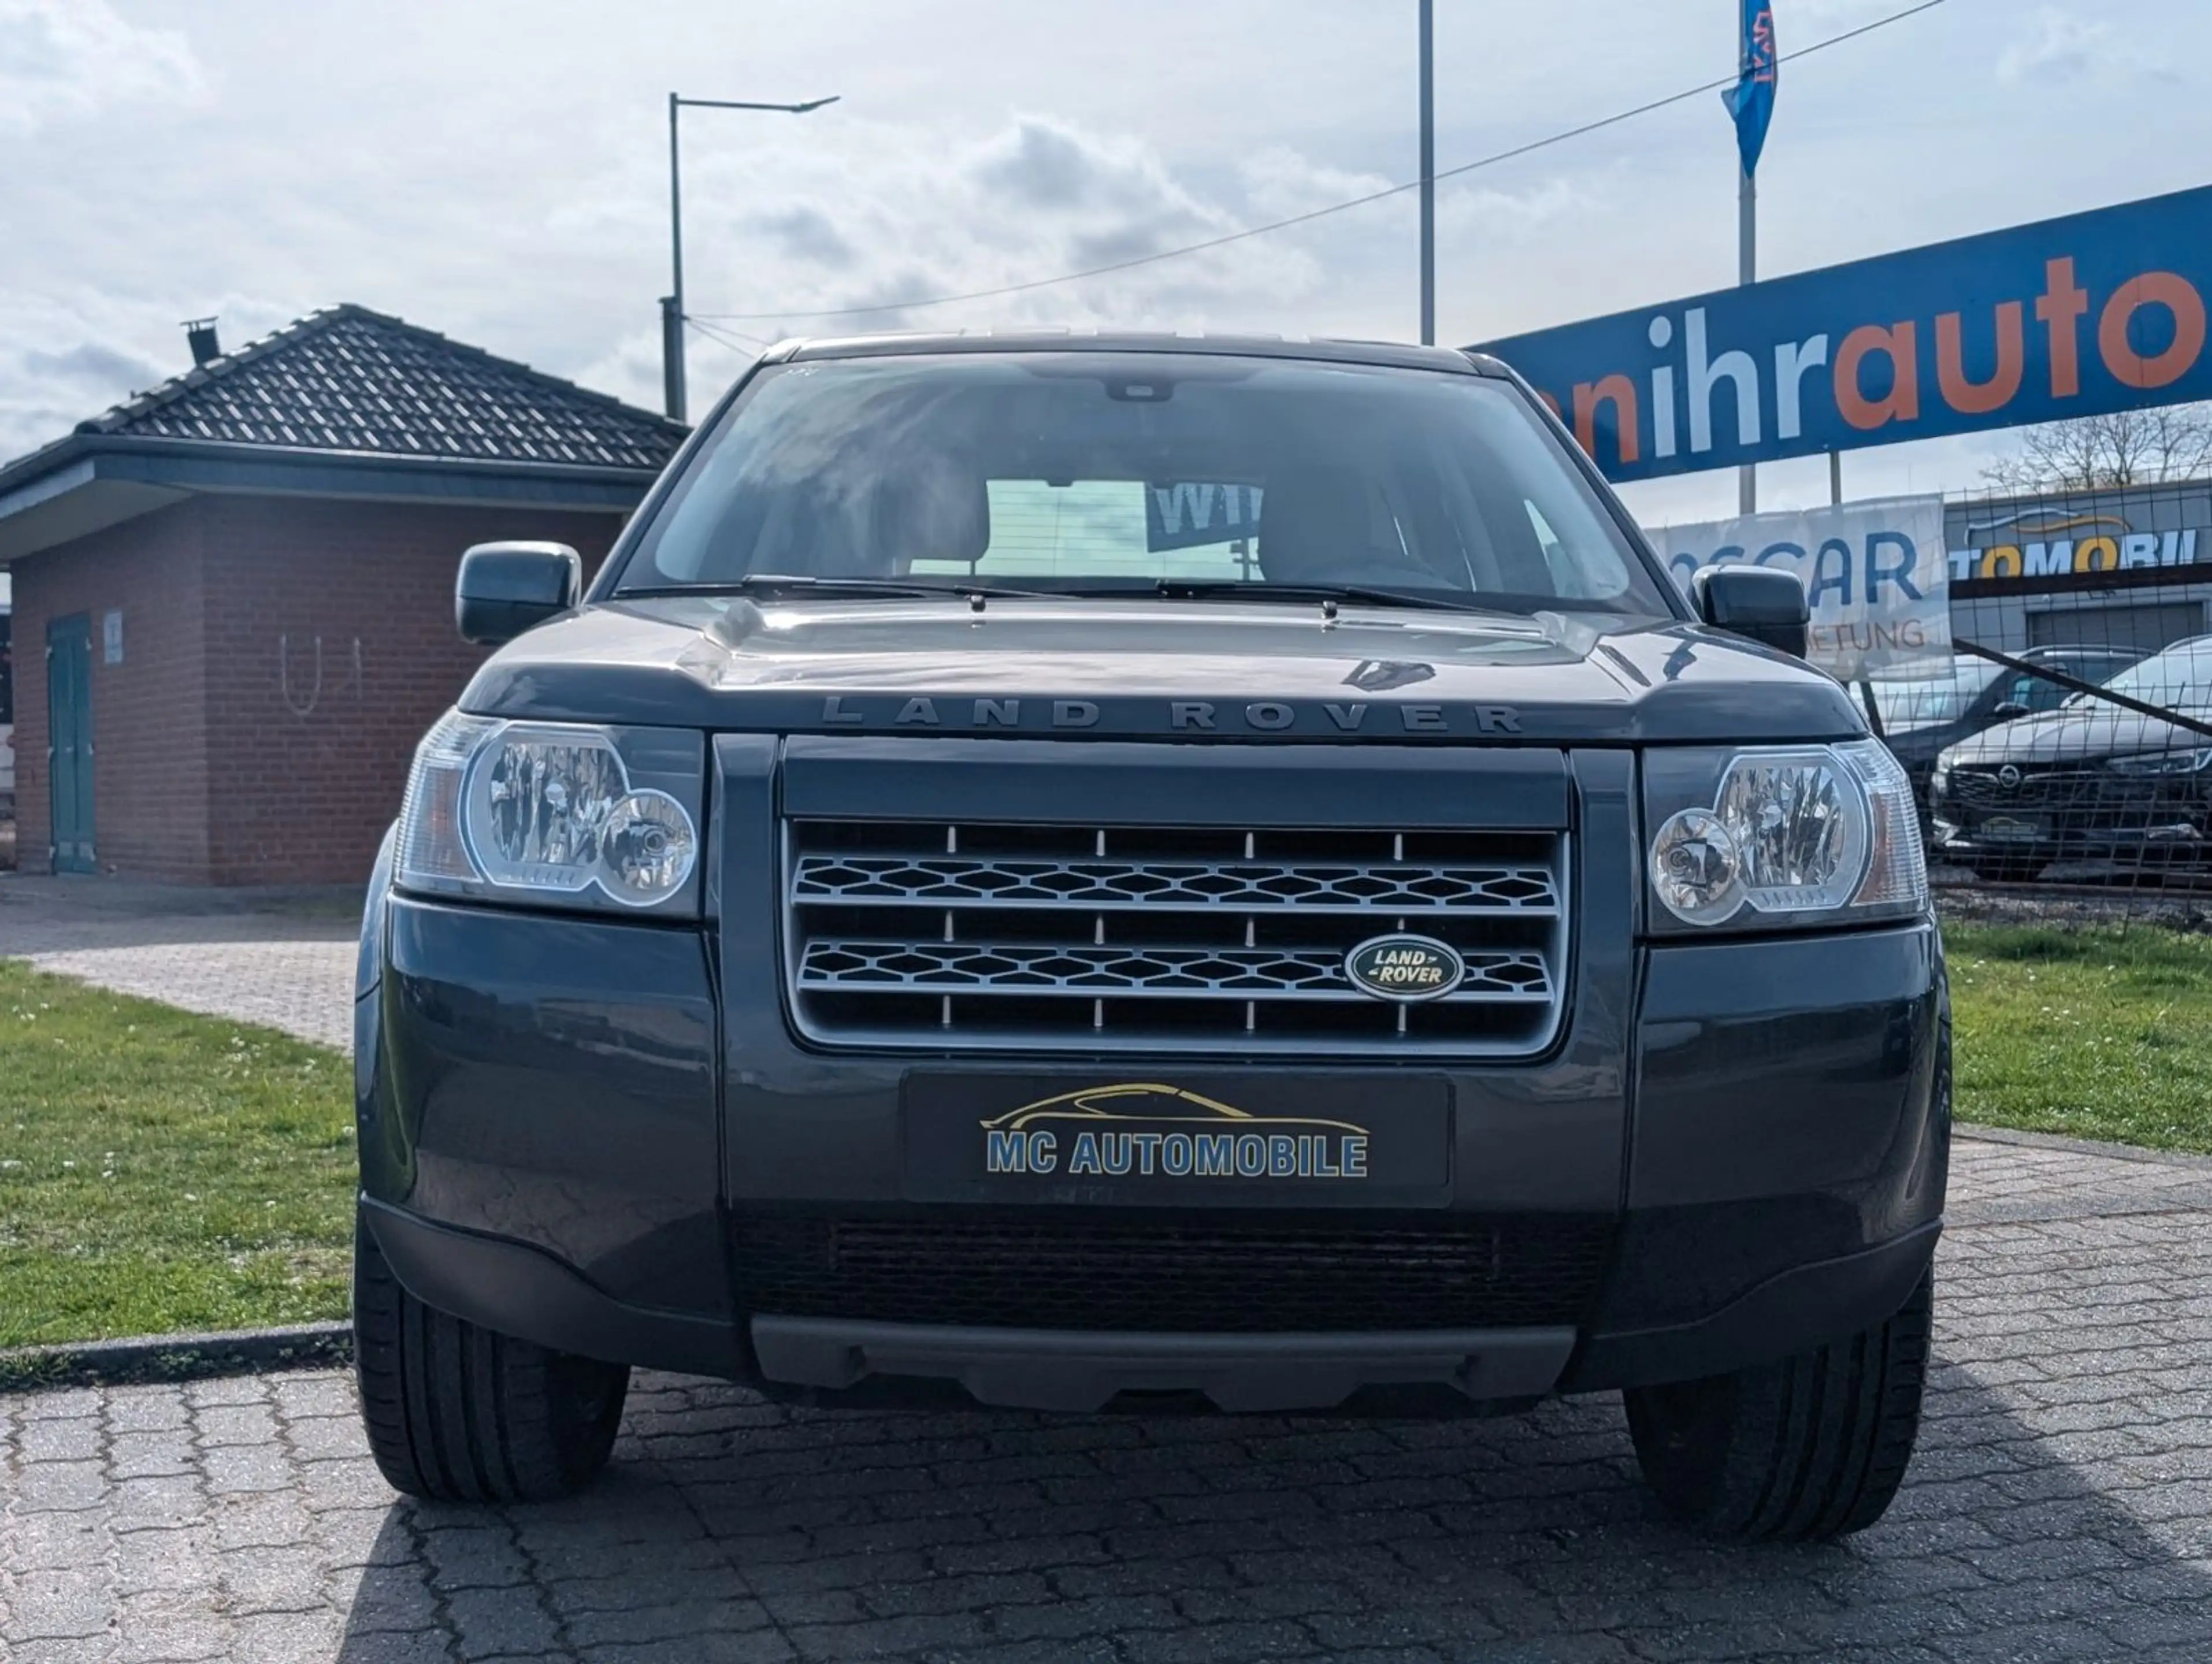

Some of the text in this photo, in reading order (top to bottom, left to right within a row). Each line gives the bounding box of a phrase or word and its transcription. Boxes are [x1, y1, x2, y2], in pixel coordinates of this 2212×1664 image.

[1669, 531, 1922, 607] OAR
[822, 696, 1523, 733] LAND ROVER
[1374, 949, 1426, 965] LAND
[1379, 966, 1443, 983] ROVER
[986, 1131, 1368, 1177] MC AUTOMOBILE
